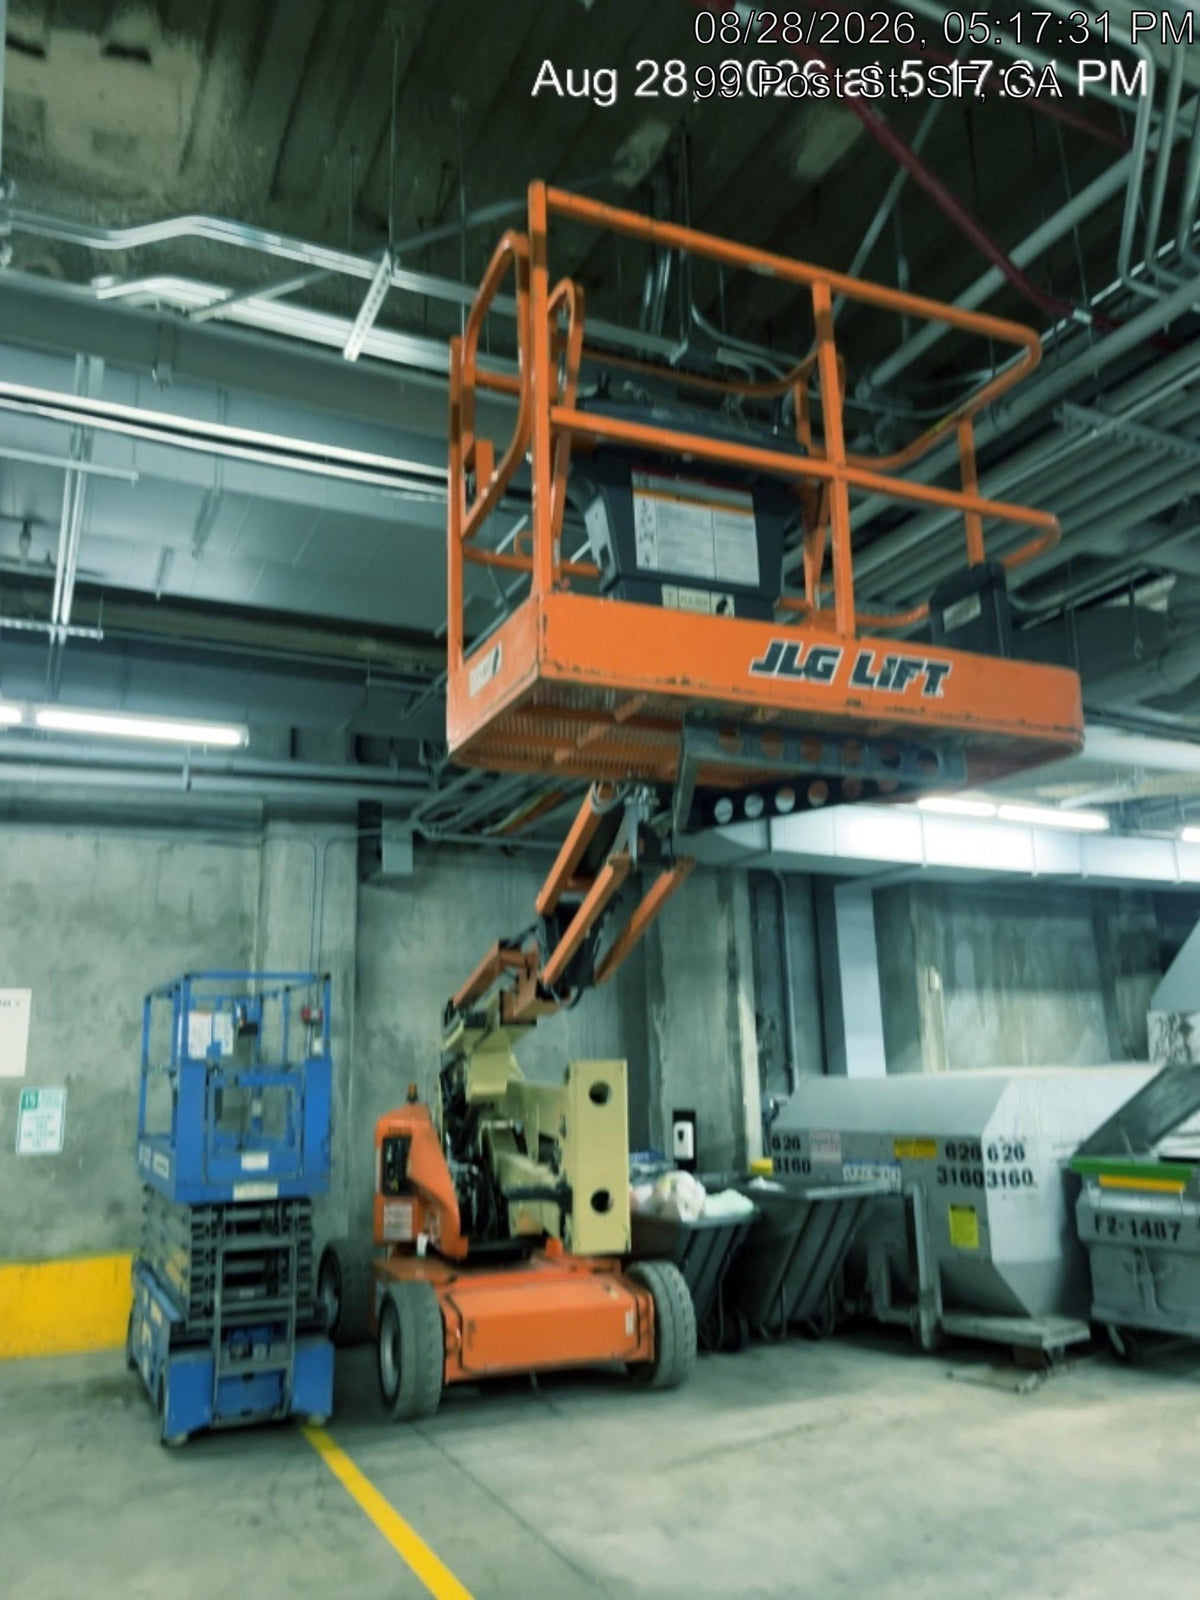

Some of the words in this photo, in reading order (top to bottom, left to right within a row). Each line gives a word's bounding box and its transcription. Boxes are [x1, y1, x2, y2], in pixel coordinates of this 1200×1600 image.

[749, 637, 843, 687] JLG
[848, 649, 953, 699] LIFT
[986, 1167, 1034, 1189] 3160
